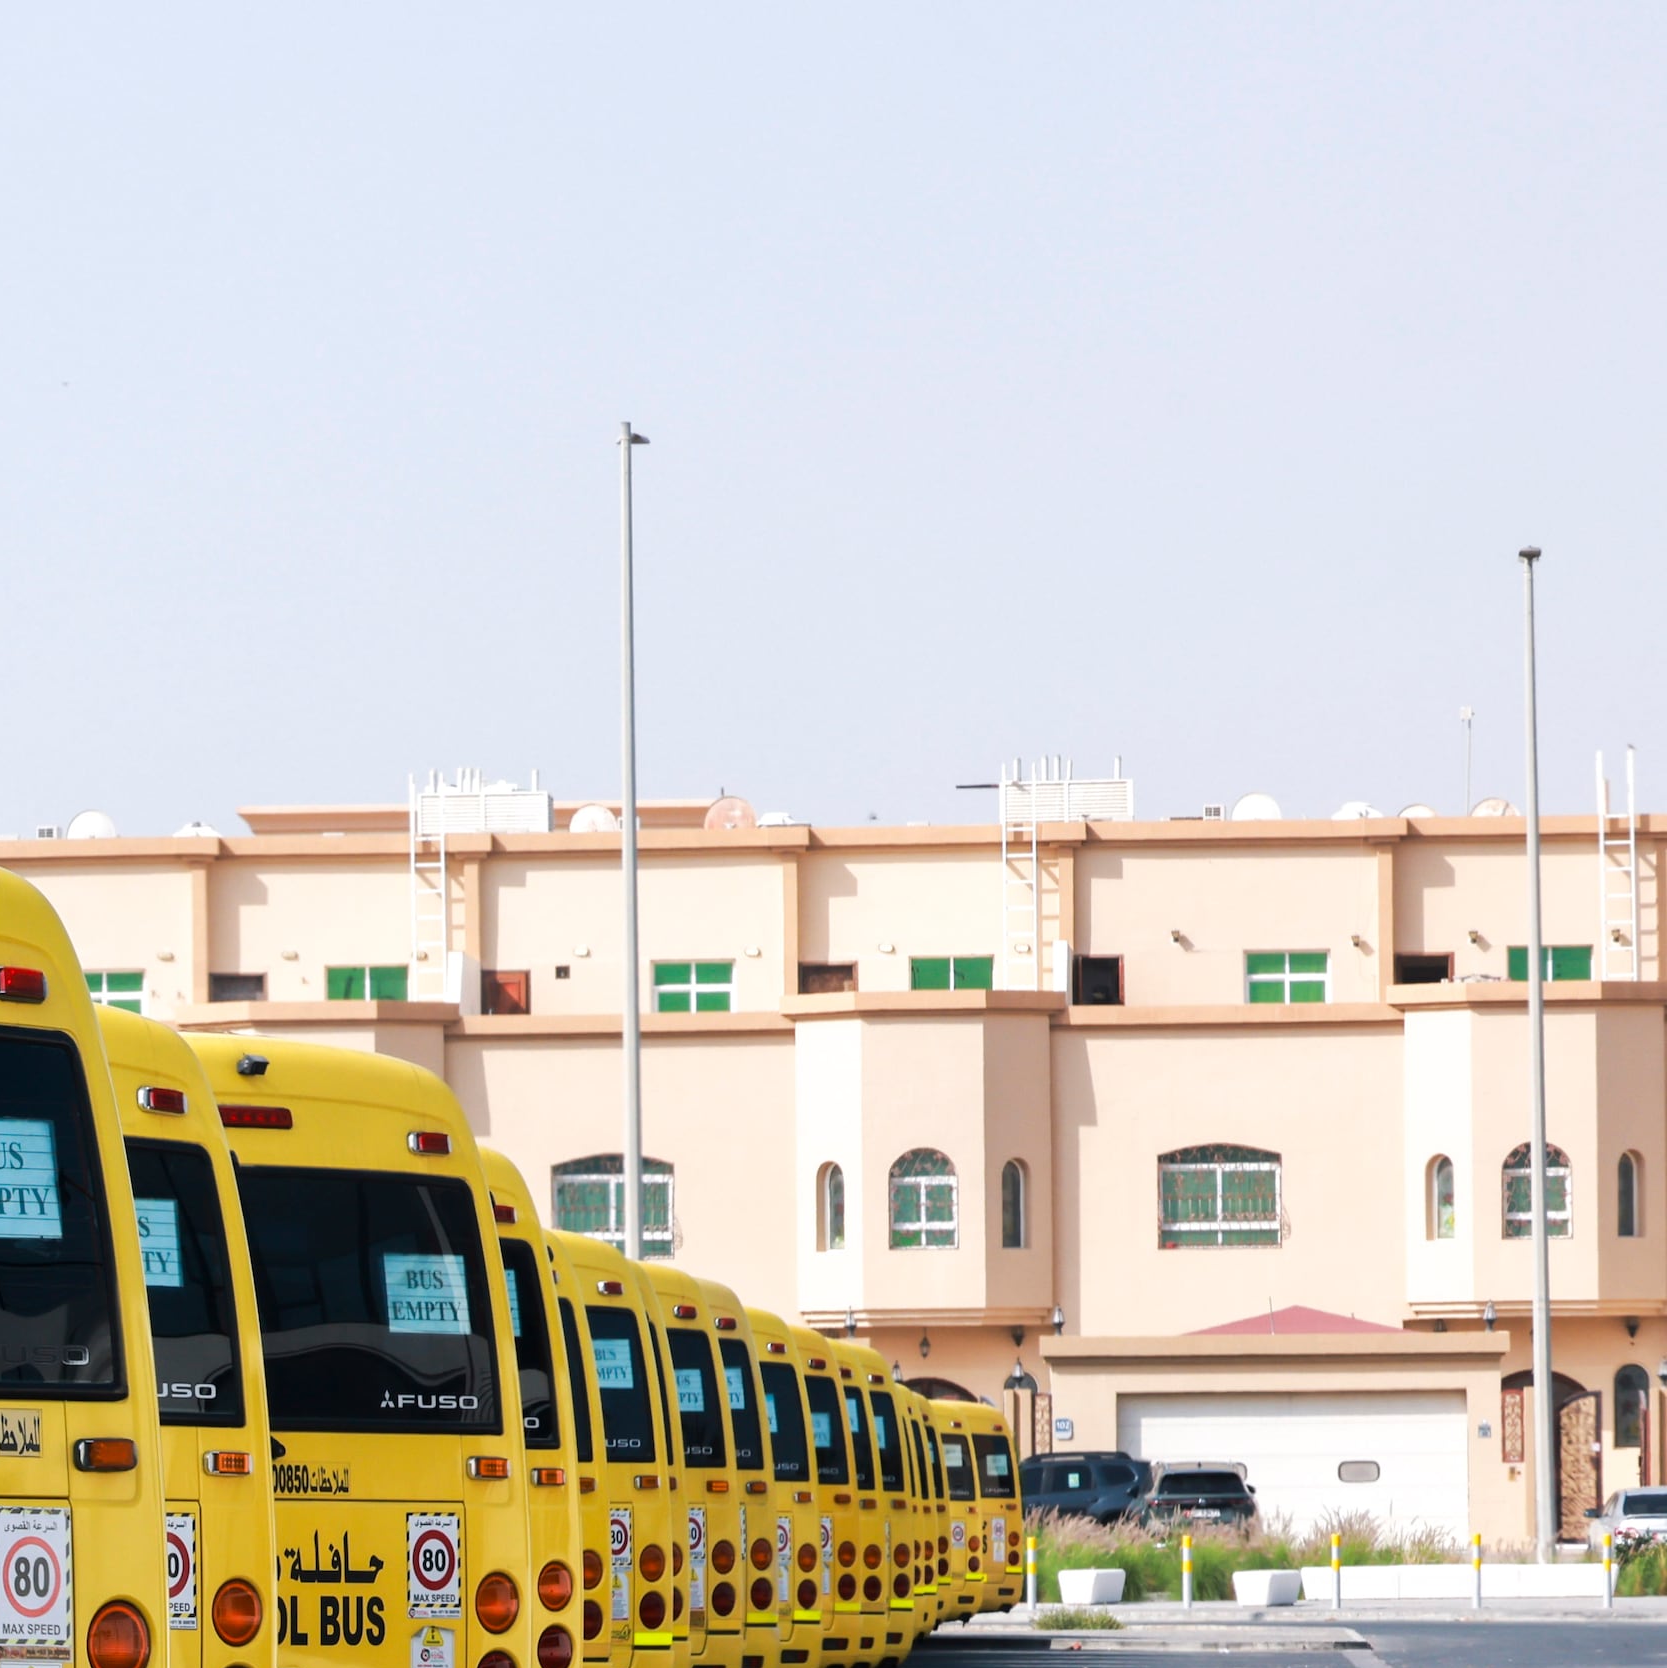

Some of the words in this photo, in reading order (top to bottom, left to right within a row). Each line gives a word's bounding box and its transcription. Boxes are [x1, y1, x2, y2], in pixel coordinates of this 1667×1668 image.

[406, 1269, 443, 1290] BUS
[392, 1300, 461, 1322] EMPTY
[598, 1366, 627, 1380] MPTY
[397, 1394, 479, 1410] FUSO
[284, 1529, 384, 1583] حافلة
[422, 1549, 446, 1572] 80
[14, 1557, 50, 1598] 80
[414, 1594, 429, 1602] MAX
[431, 1594, 455, 1602] SPEED
[2, 1624, 24, 1635] MAX
[27, 1624, 60, 1636] SPEED
[320, 1595, 385, 1646] BUS
